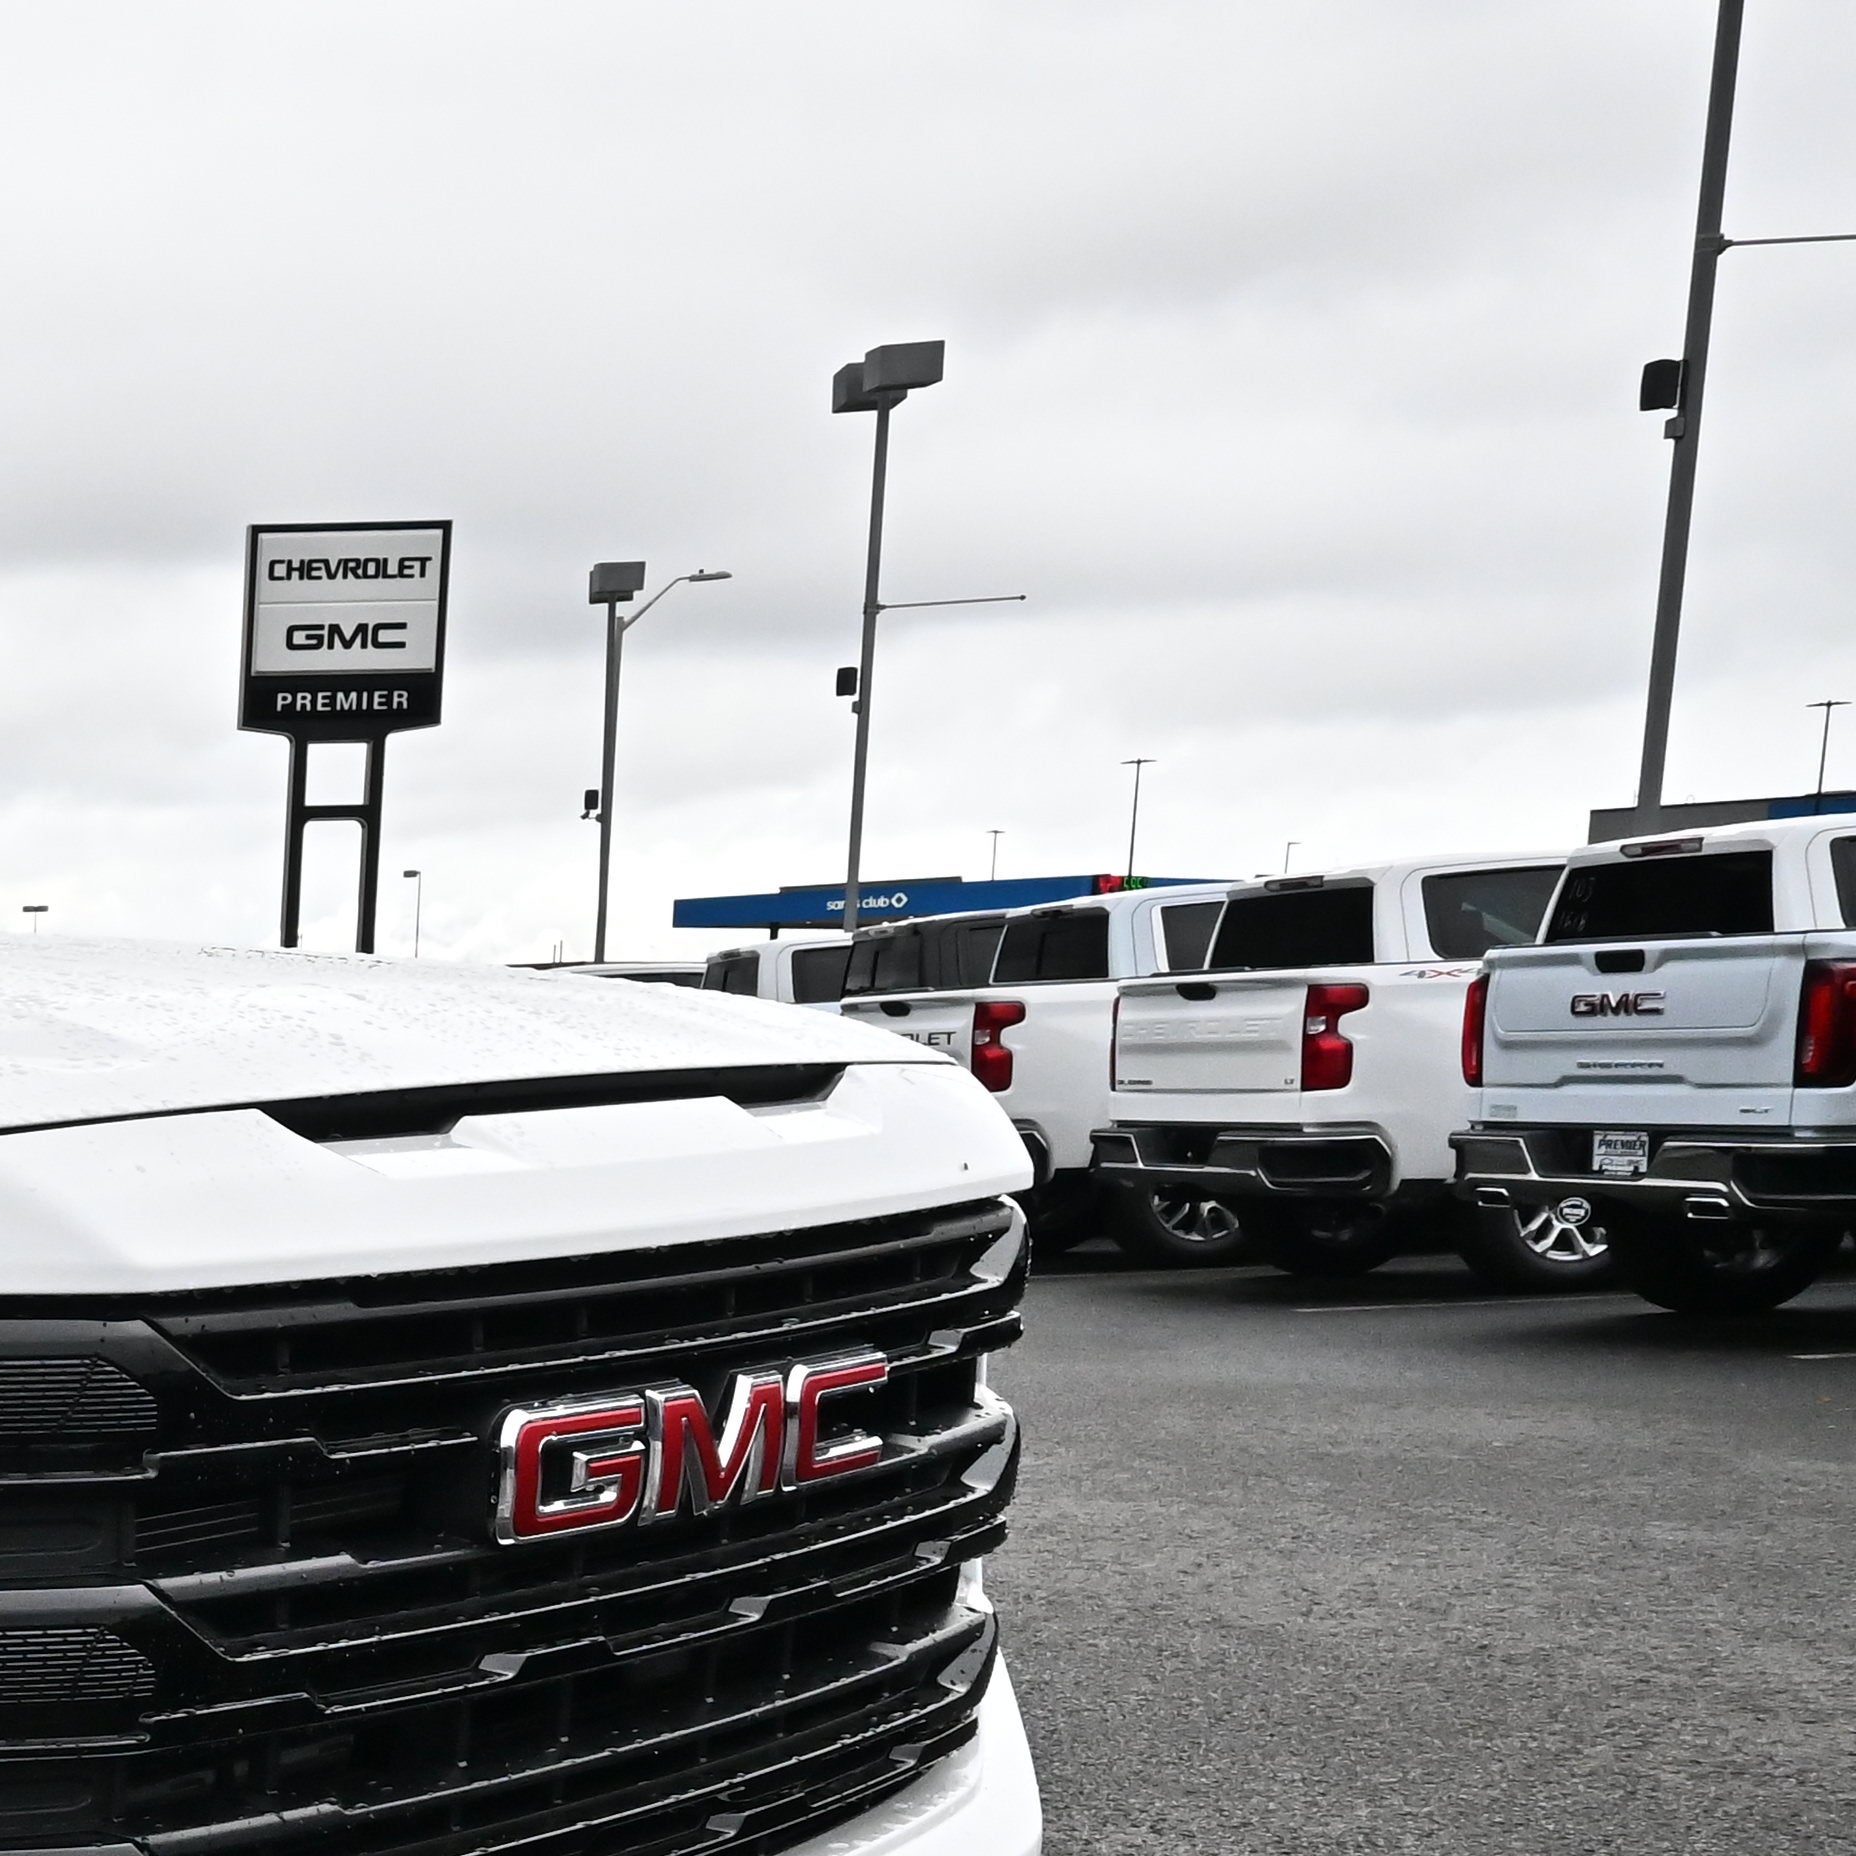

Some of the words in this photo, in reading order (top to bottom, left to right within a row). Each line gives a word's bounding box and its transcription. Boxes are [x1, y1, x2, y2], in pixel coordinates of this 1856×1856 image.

[267, 556, 433, 582] CHEVROLET
[285, 622, 408, 651] GMC
[276, 690, 409, 712] PREMIER
[862, 895, 890, 909] club
[1570, 990, 1666, 1017] GMC
[493, 1345, 889, 1546] GMC
